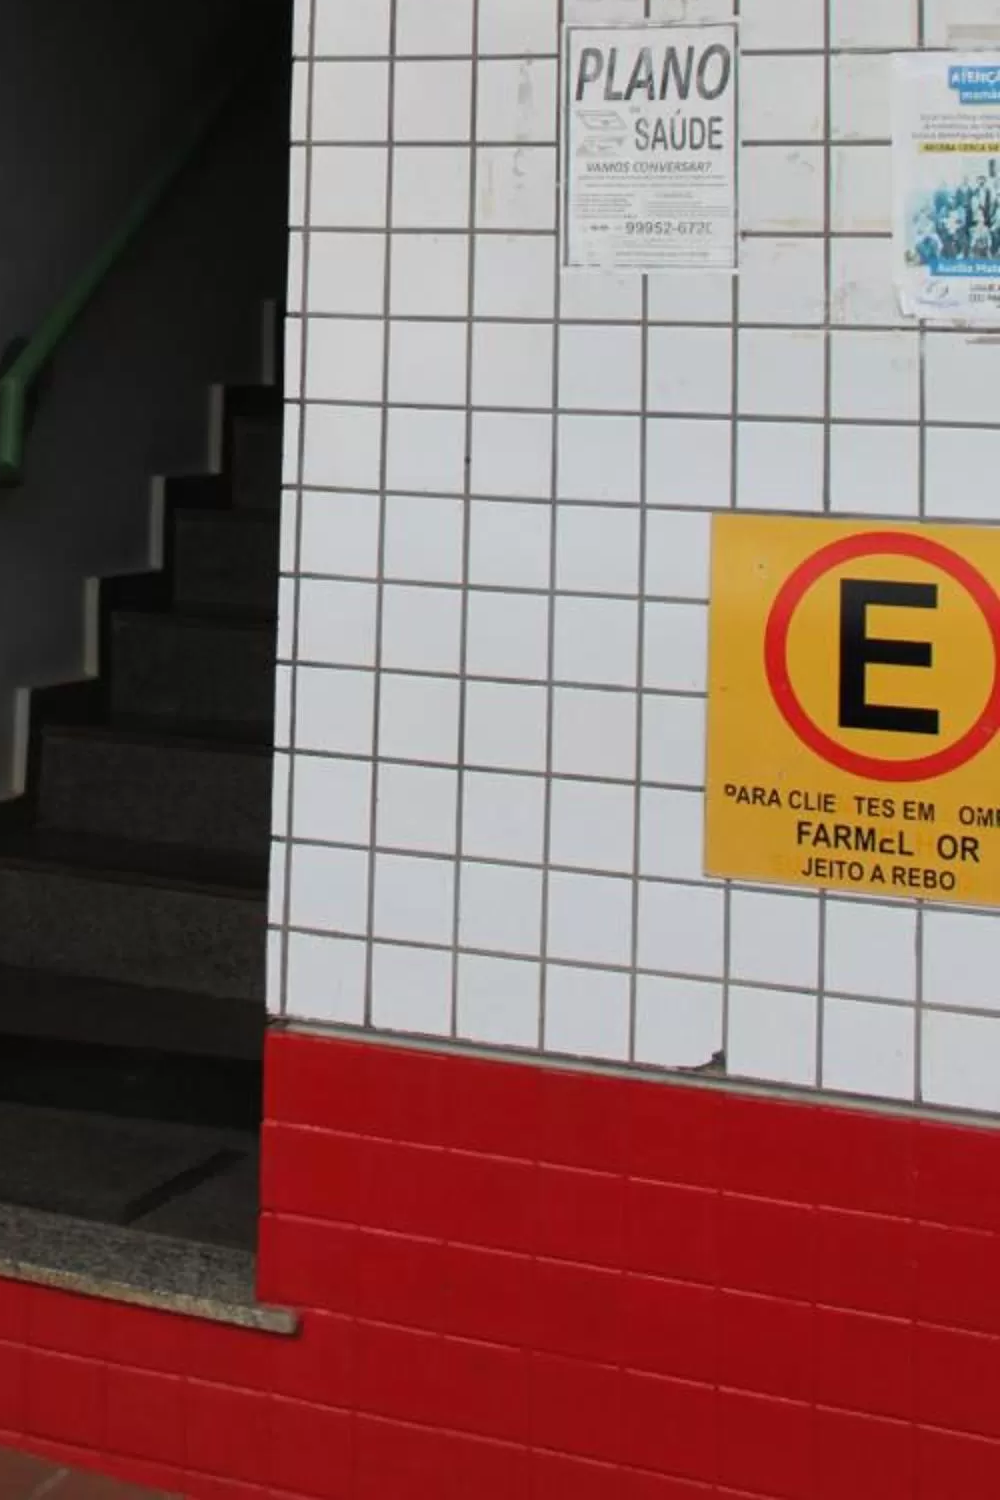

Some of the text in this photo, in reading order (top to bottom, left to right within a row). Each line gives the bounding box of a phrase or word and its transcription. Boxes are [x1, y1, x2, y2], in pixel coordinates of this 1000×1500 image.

[575, 43, 732, 101] PLANO
[634, 108, 724, 152] SAÚDE
[586, 161, 630, 173] VAMOS
[837, 577, 941, 735] E
[724, 783, 782, 808] PARA
[903, 799, 935, 822] EM
[870, 865, 887, 885] A
